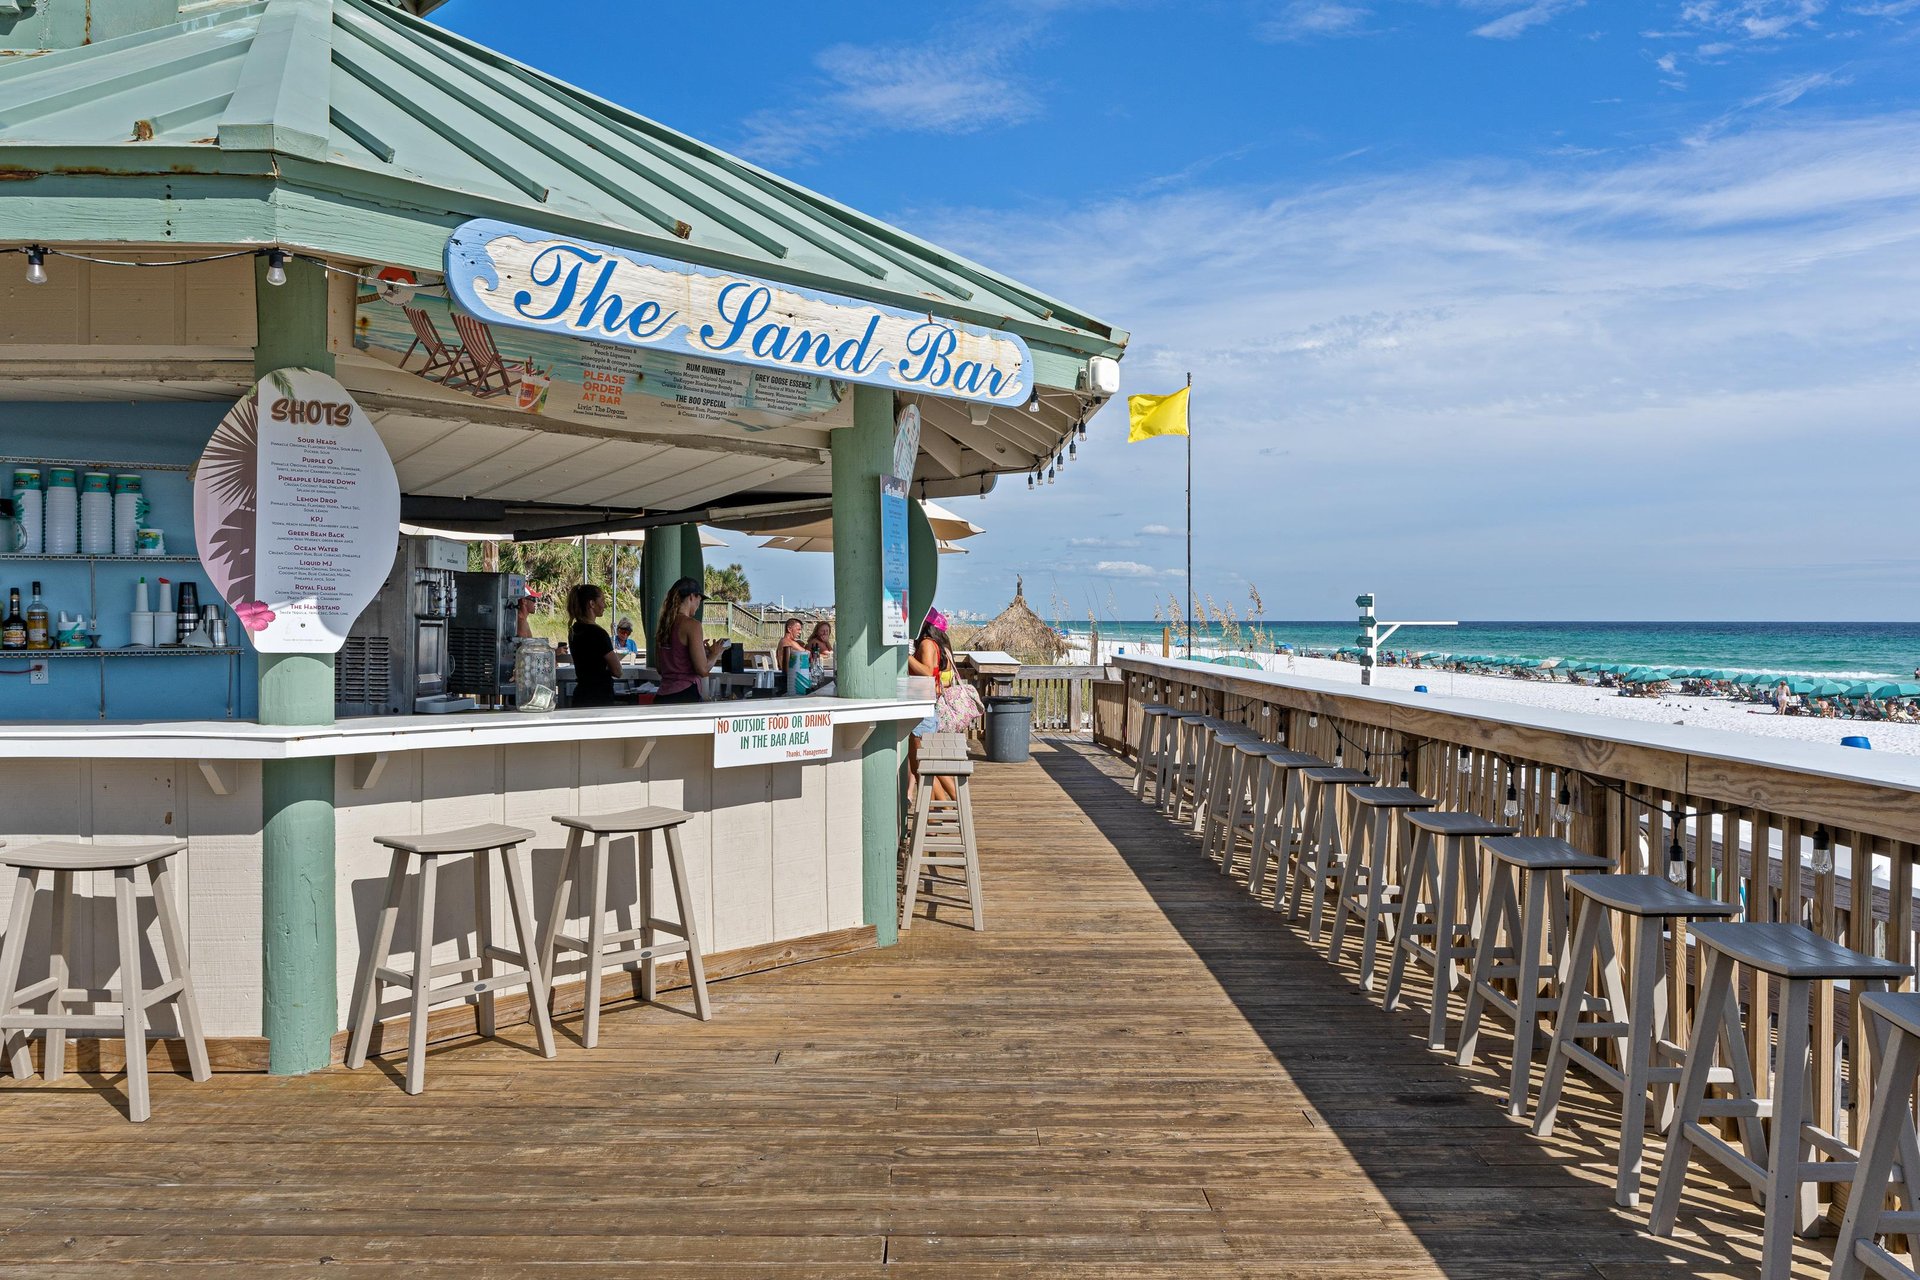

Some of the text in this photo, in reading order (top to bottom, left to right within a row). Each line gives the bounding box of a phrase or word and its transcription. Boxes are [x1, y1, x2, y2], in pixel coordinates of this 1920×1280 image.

[514, 245, 1015, 397] The Sand Bar
[686, 363, 726, 376] RUM RUNNER
[584, 370, 626, 384] PLEASE
[755, 373, 812, 389] GREY GOOSE ESSENCE
[583, 381, 622, 394] ORDER
[695, 380, 717, 388] Blackberry
[582, 393, 621, 405] AT BAR
[676, 394, 726, 408] THE BOO SPECIAL
[271, 398, 353, 426] SHOTS
[607, 407, 625, 415] Dream
[707, 408, 727, 416] Pineapple
[717, 713, 831, 734] NO OUTSIDE FOOD OR DRINKS
[740, 731, 810, 750] IN THE BAR AREA
[803, 748, 828, 757] Management
